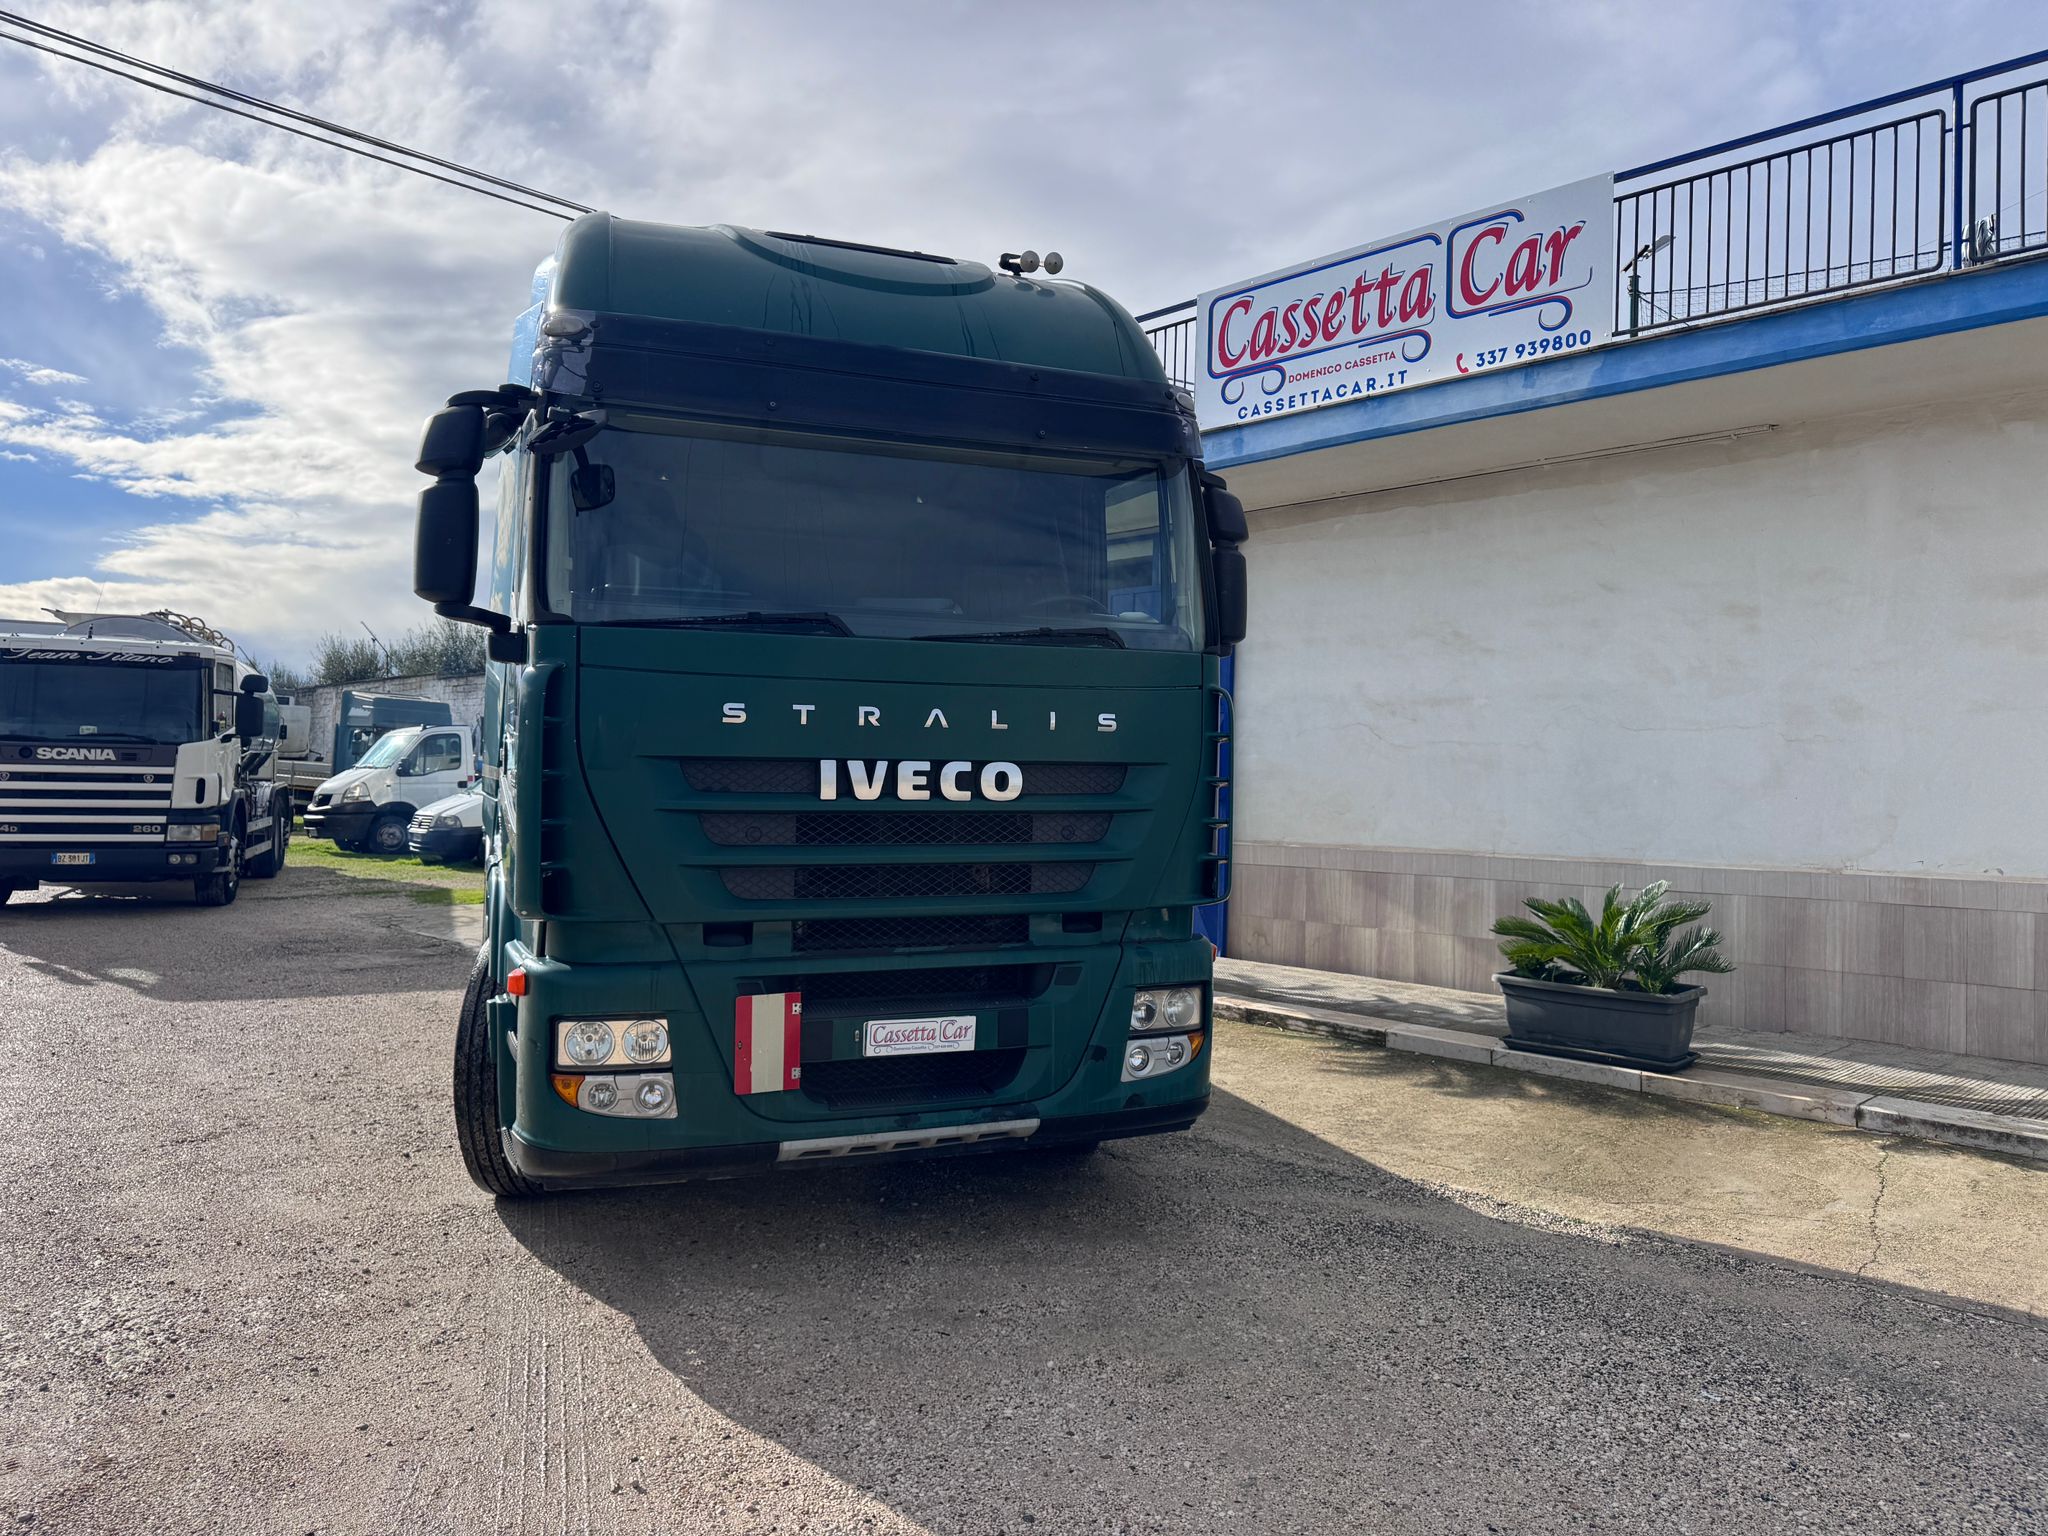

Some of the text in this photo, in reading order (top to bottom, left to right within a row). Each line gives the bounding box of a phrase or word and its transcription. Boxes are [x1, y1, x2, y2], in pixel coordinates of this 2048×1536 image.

[1217, 219, 1588, 368] Cassetta Car
[1475, 328, 1592, 368] 337 939800
[1288, 350, 1397, 384] DOMENICO CASSETTA
[1237, 369, 1408, 420] CASSETTACAR.IT
[3, 647, 81, 660] Team
[721, 702, 1118, 733] STRALIS
[36, 747, 117, 761] SCANIA
[818, 759, 1024, 802] IVECO
[132, 825, 161, 833] 260
[872, 1020, 973, 1044] Cassetta Car
